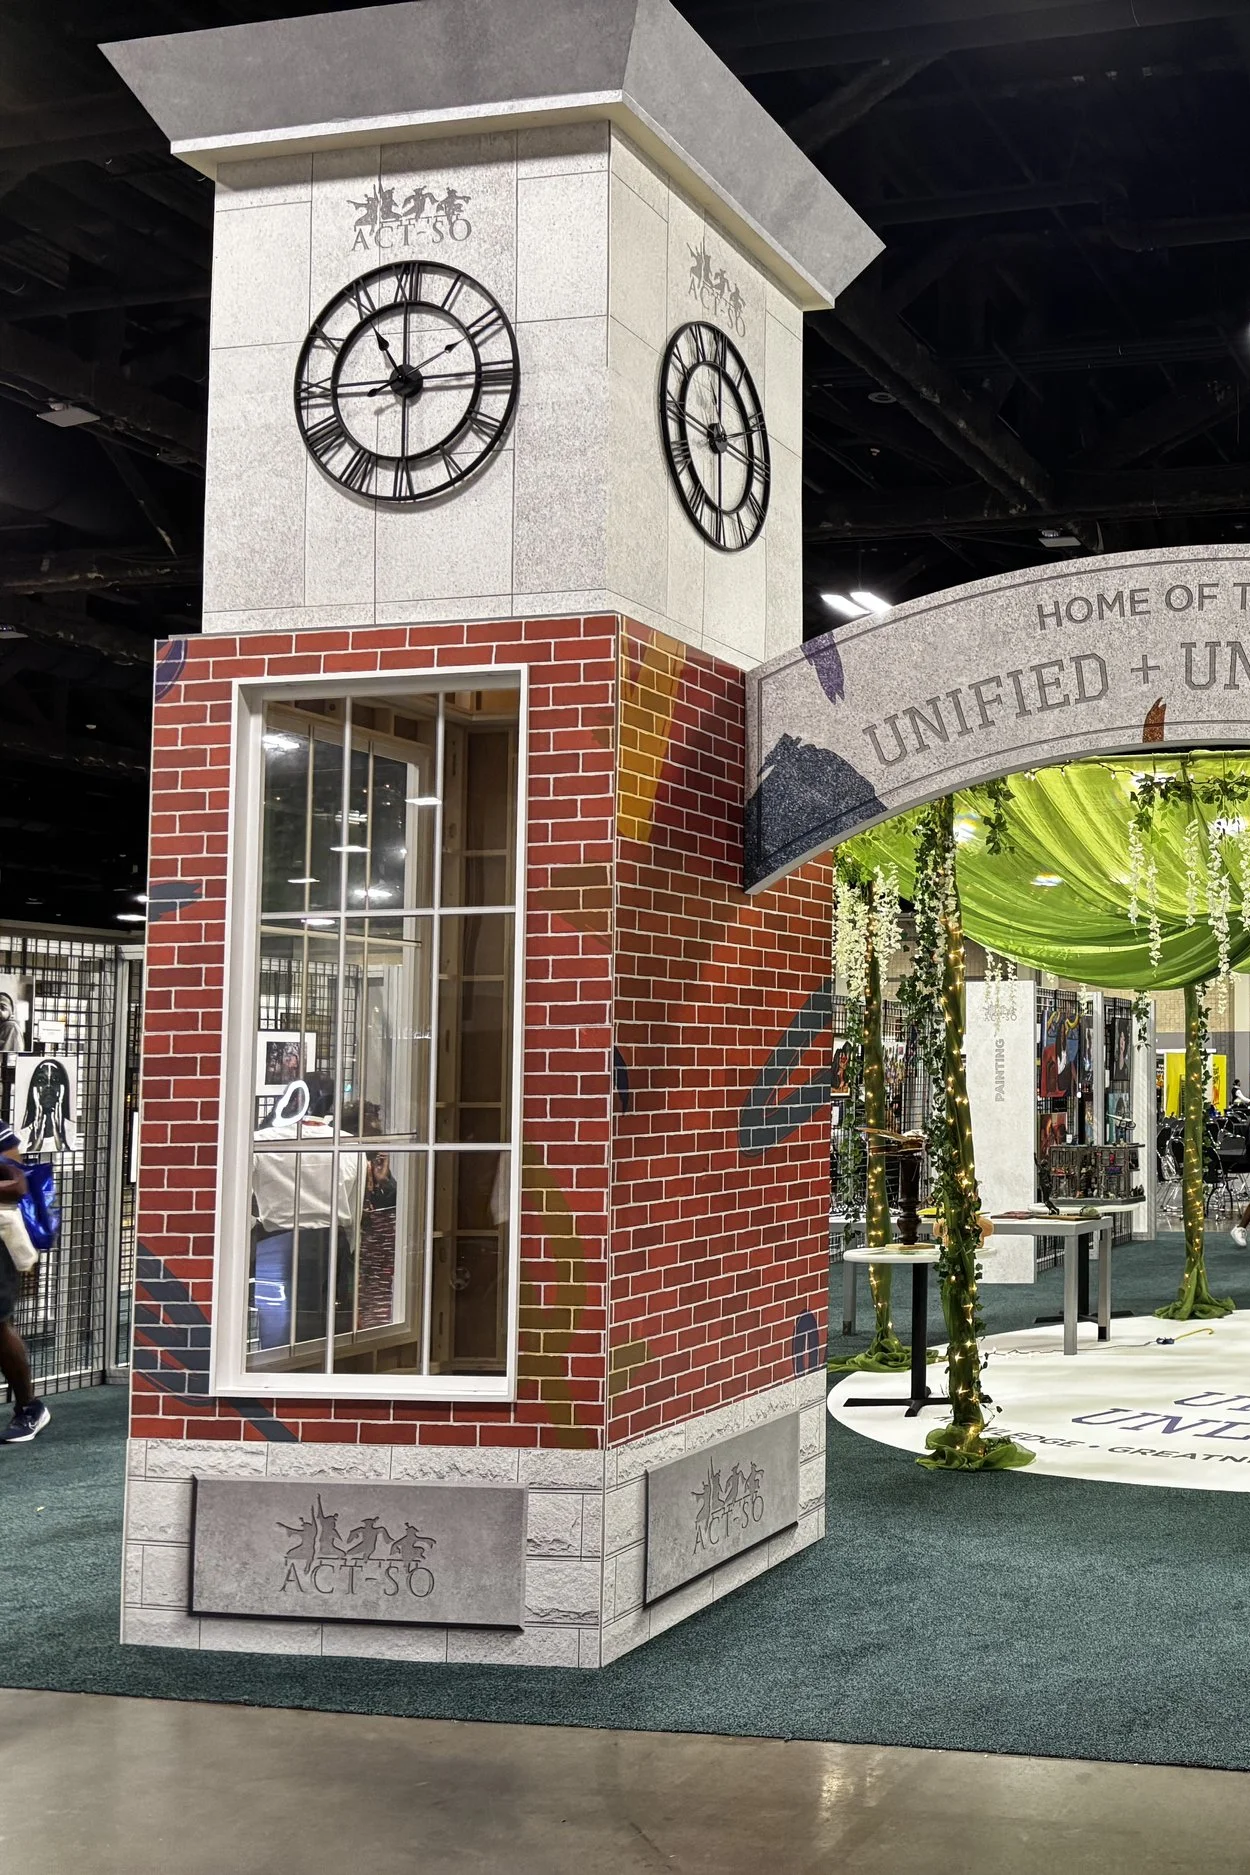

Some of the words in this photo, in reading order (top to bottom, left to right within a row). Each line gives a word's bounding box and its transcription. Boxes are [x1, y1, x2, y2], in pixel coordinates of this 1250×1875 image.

[351, 217, 472, 252] ACT-SO
[687, 276, 746, 338] ACT-SO
[1037, 587, 1150, 631] HOME
[1165, 582, 1219, 612] OF
[862, 652, 1108, 766] UNIFIED
[1131, 654, 1161, 685] +
[995, 1038, 1005, 1102] PAINTING
[691, 1495, 765, 1556] ACT-SO
[279, 1562, 435, 1598] ACT-SO
